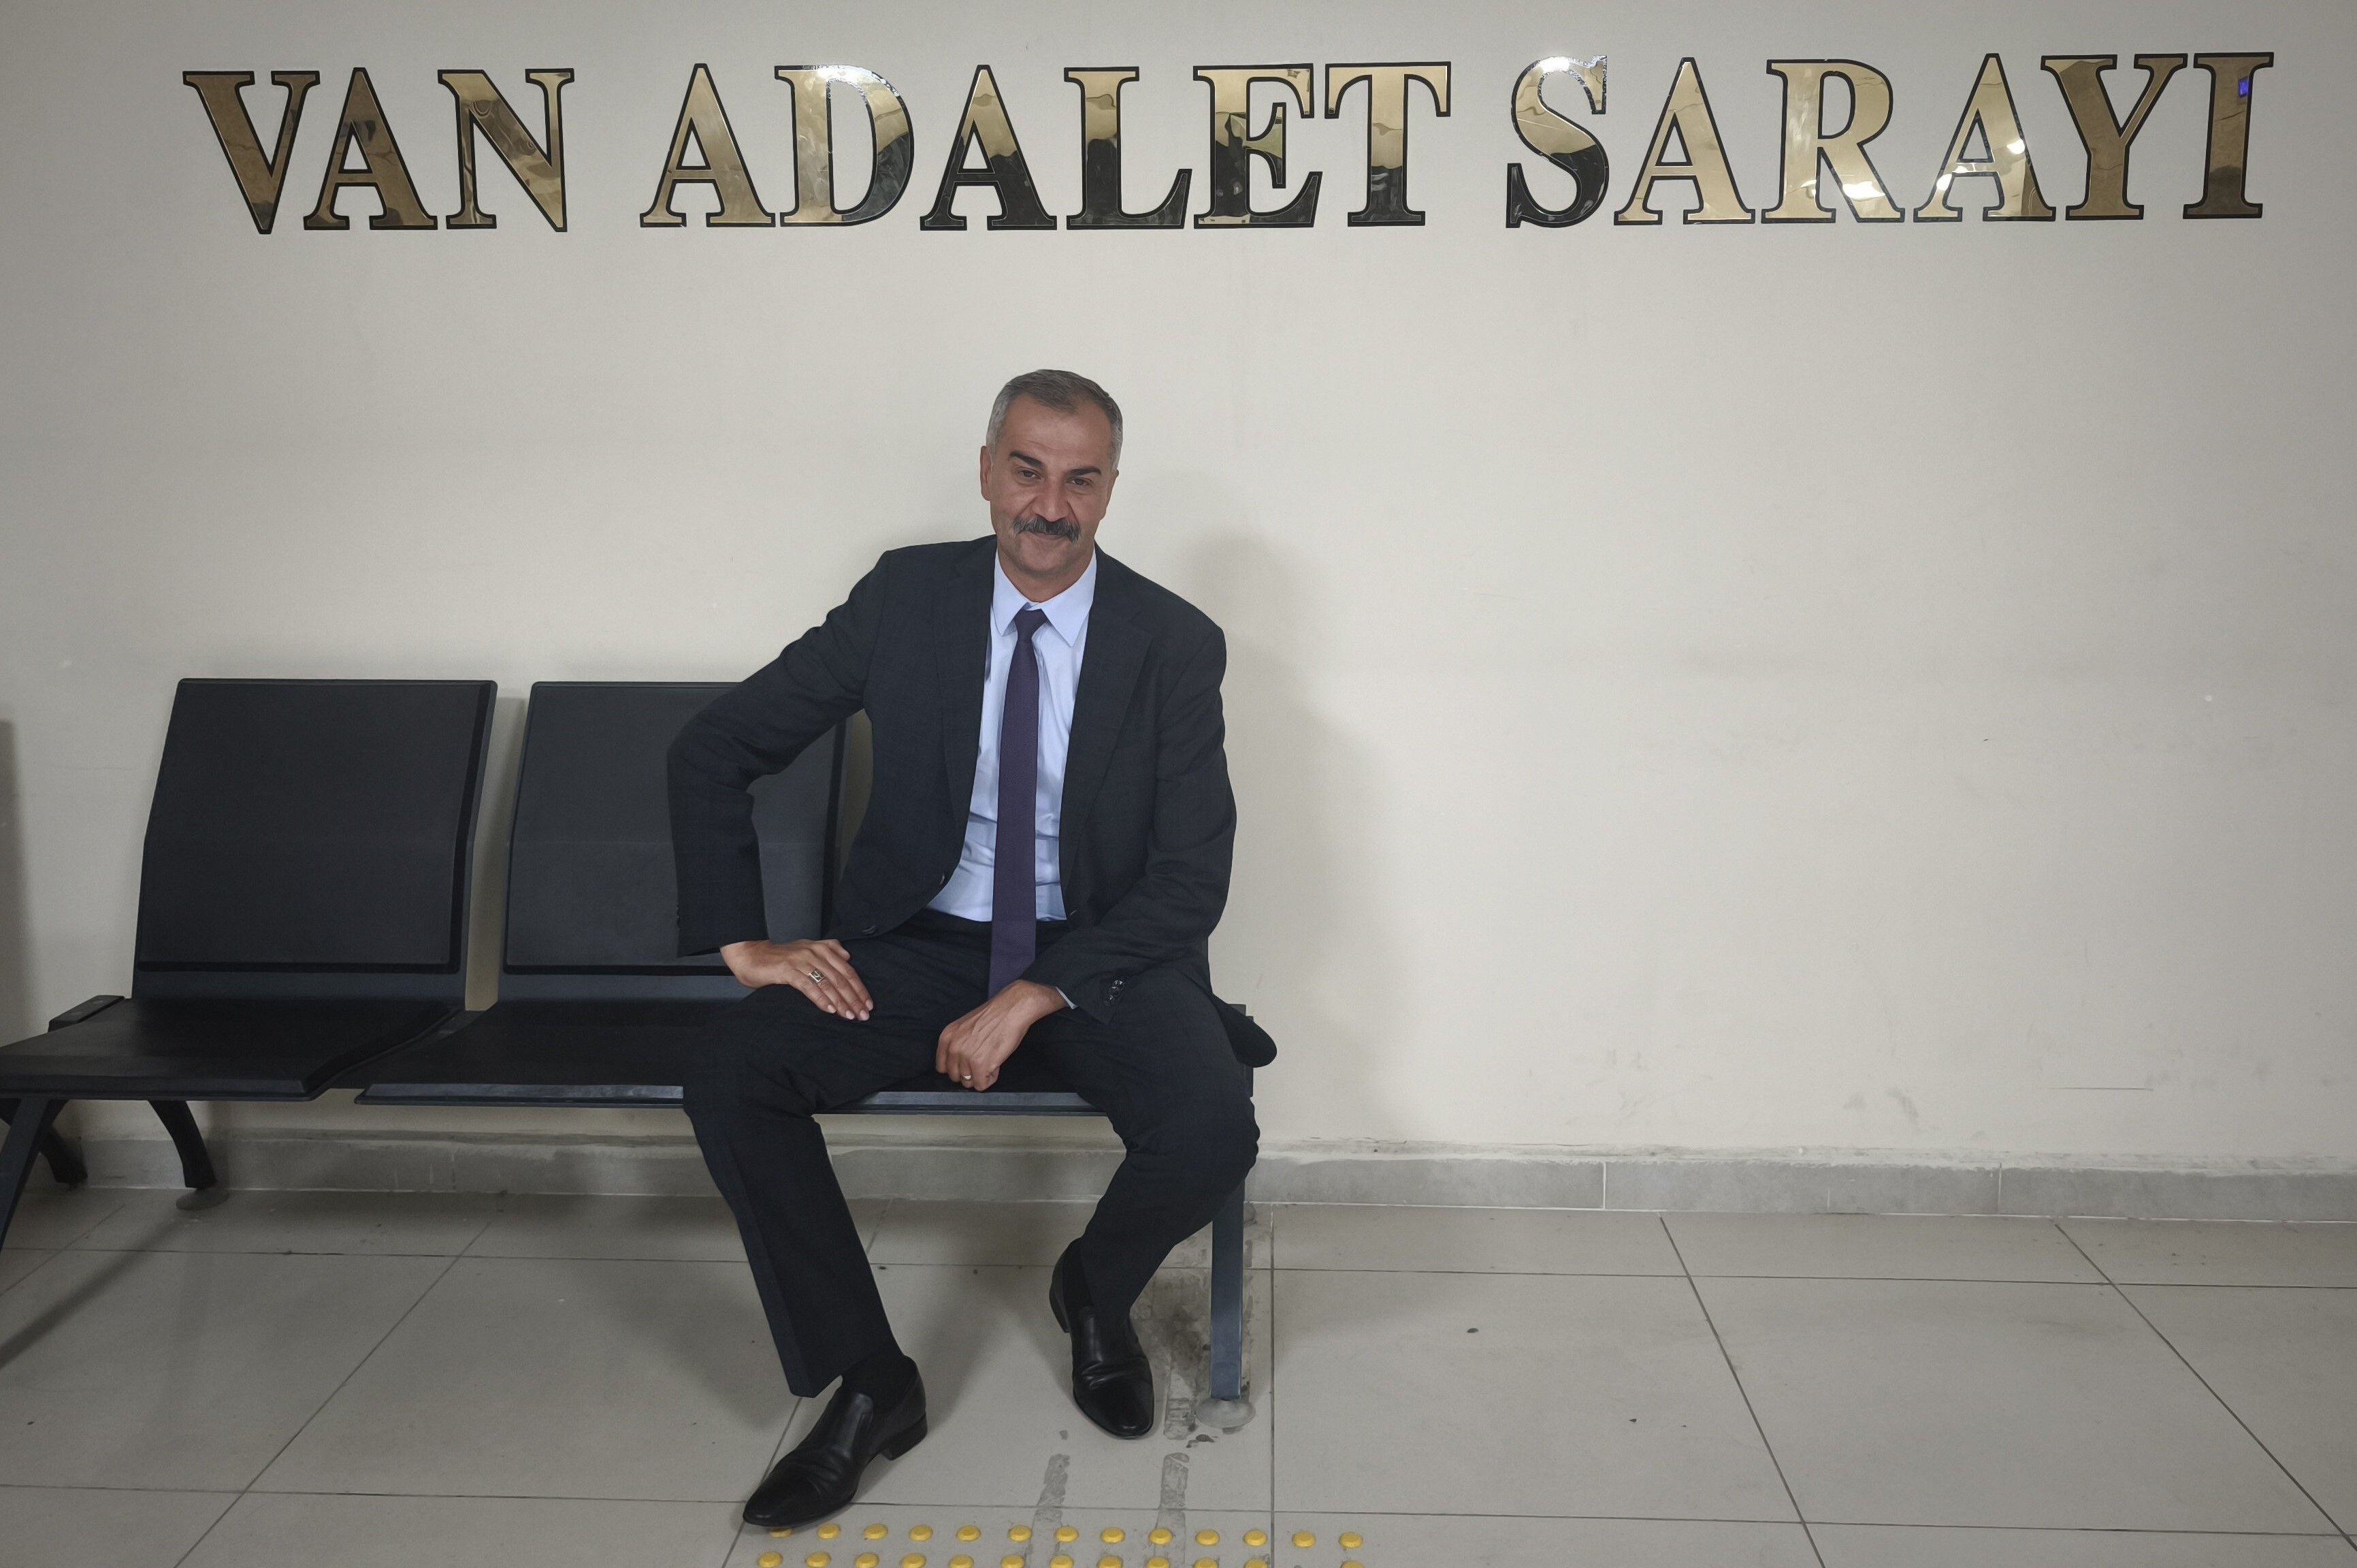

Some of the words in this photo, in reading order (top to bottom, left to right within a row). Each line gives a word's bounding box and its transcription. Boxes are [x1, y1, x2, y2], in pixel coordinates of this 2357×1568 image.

[182, 67, 574, 234] VAN
[640, 61, 1450, 231] ADALET
[1506, 52, 2275, 228] SARAYI
